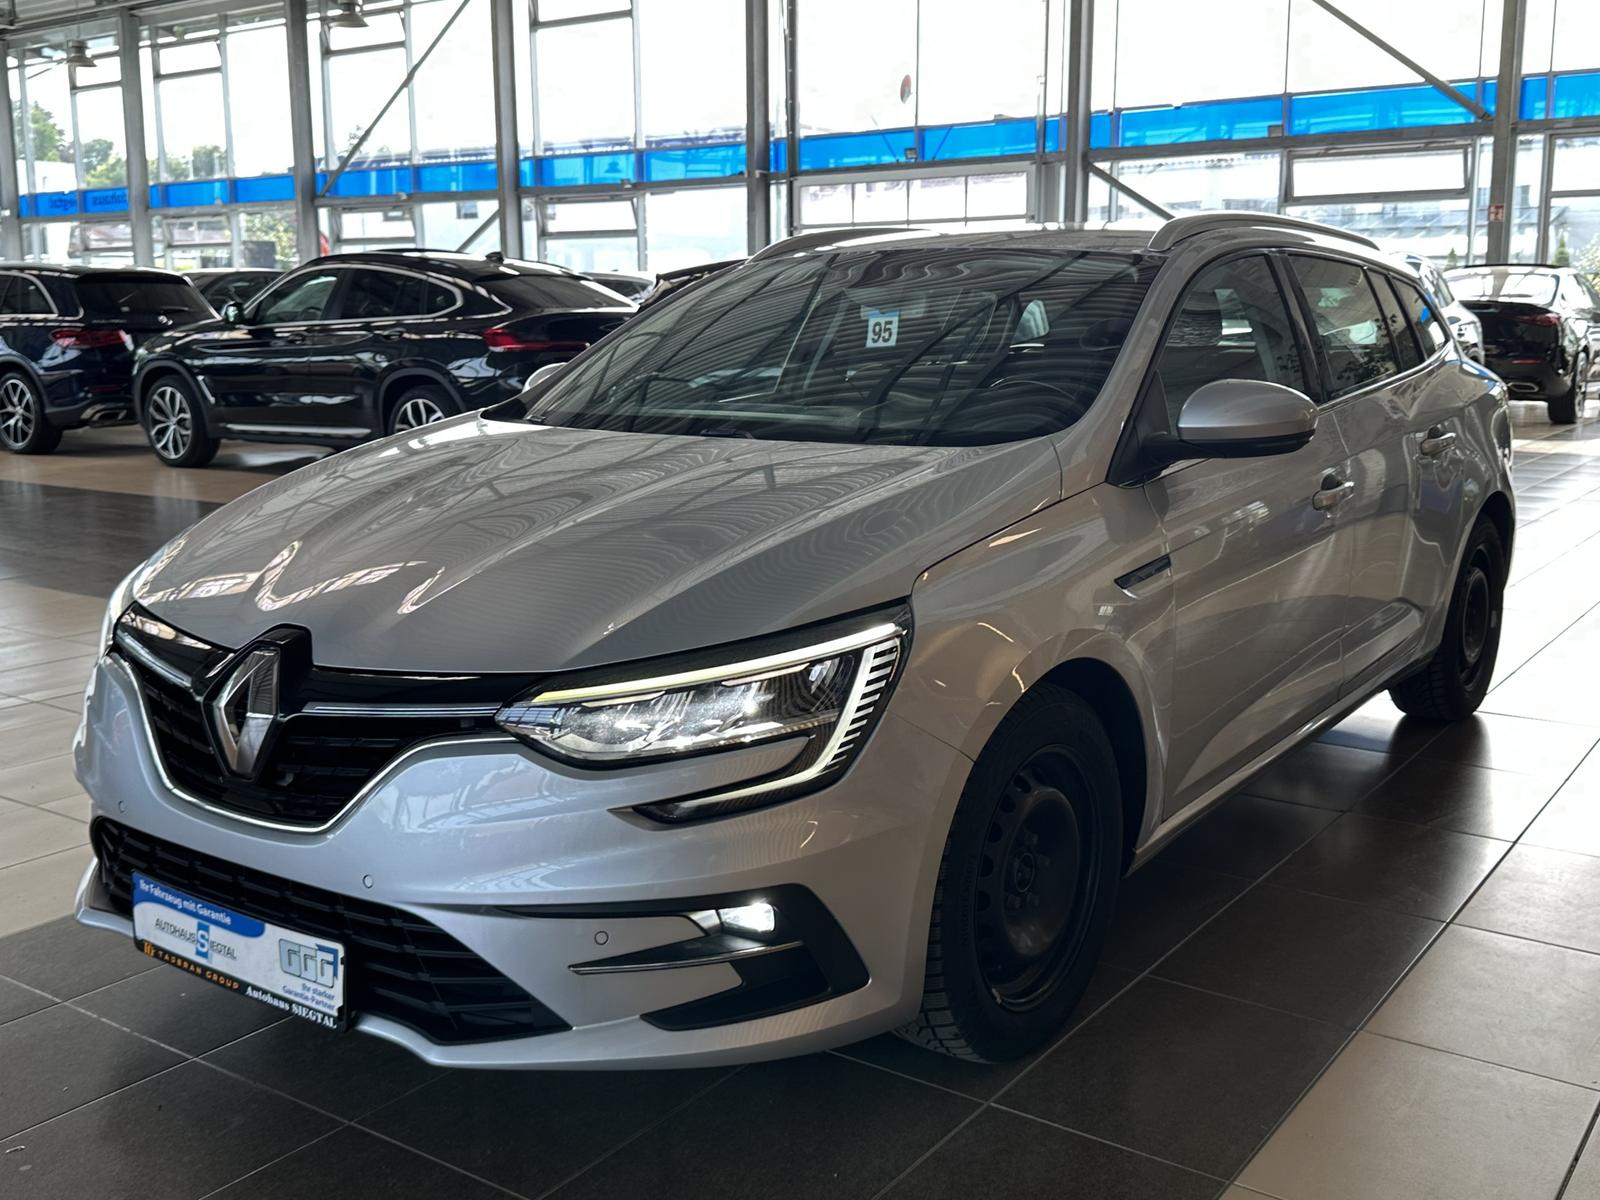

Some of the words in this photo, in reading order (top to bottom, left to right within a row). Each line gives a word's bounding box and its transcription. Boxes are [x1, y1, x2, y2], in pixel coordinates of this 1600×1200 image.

[872, 321, 893, 343] 95
[149, 883, 183, 909] Fahrzeug
[183, 900, 196, 912] mit
[196, 904, 232, 925] Garantie
[155, 918, 196, 944] AUTOHAUS
[206, 970, 240, 990] GROUP
[245, 985, 290, 1011] Autohaus
[291, 1003, 338, 1029] SIEGTAL
